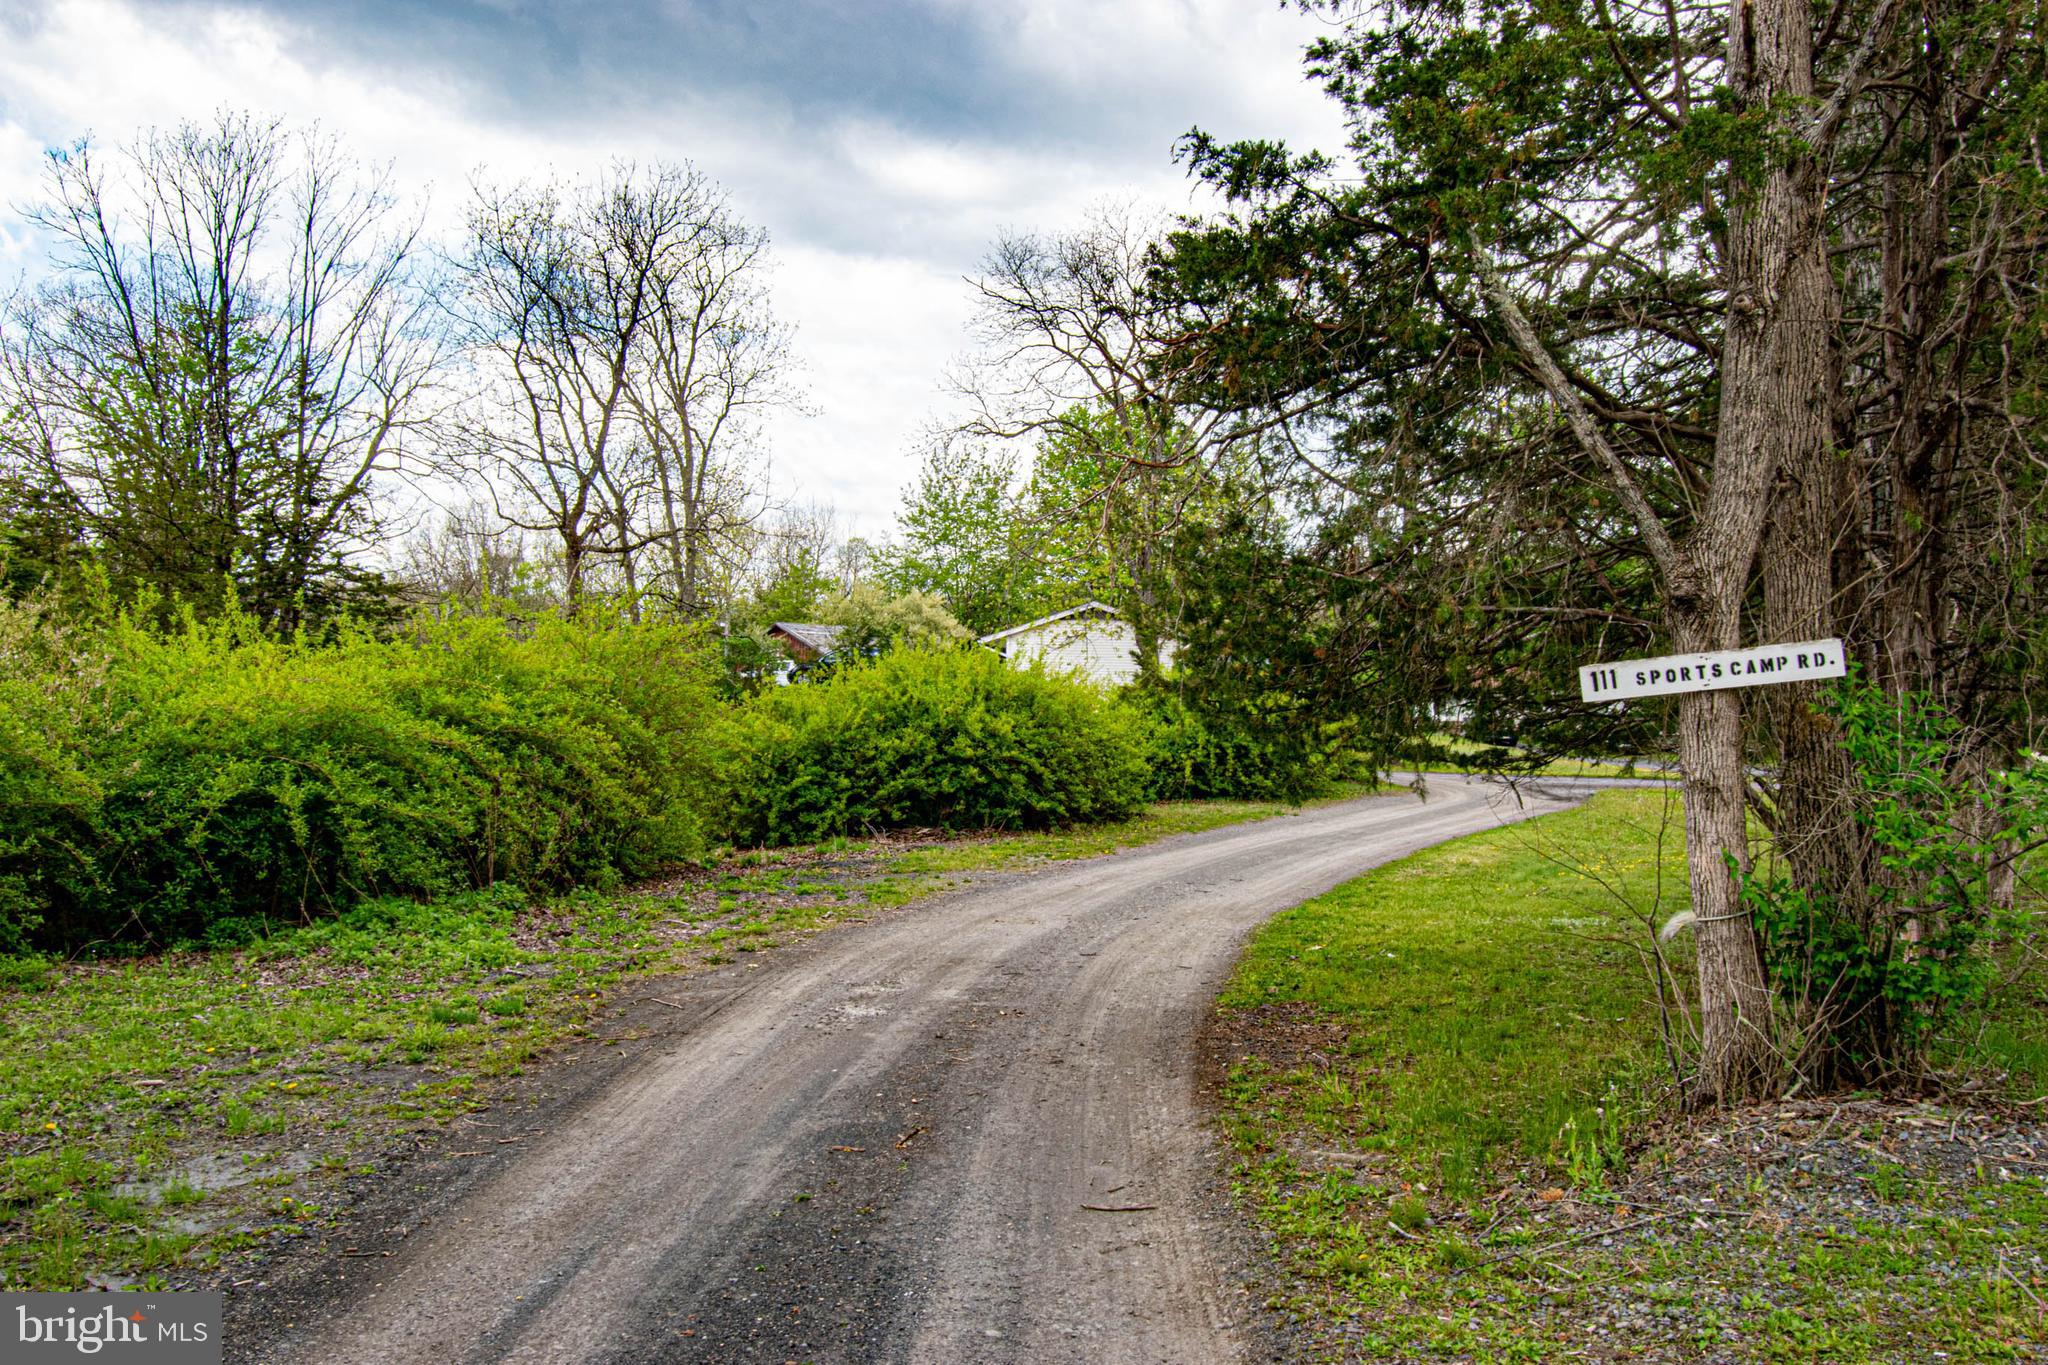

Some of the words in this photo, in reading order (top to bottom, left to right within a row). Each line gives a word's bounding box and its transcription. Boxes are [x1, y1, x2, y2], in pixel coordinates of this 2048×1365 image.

[1590, 669, 1618, 692] 111
[1636, 663, 1723, 686] SPORTS
[1730, 656, 1788, 676] CAMP
[1797, 651, 1835, 669] RD.
